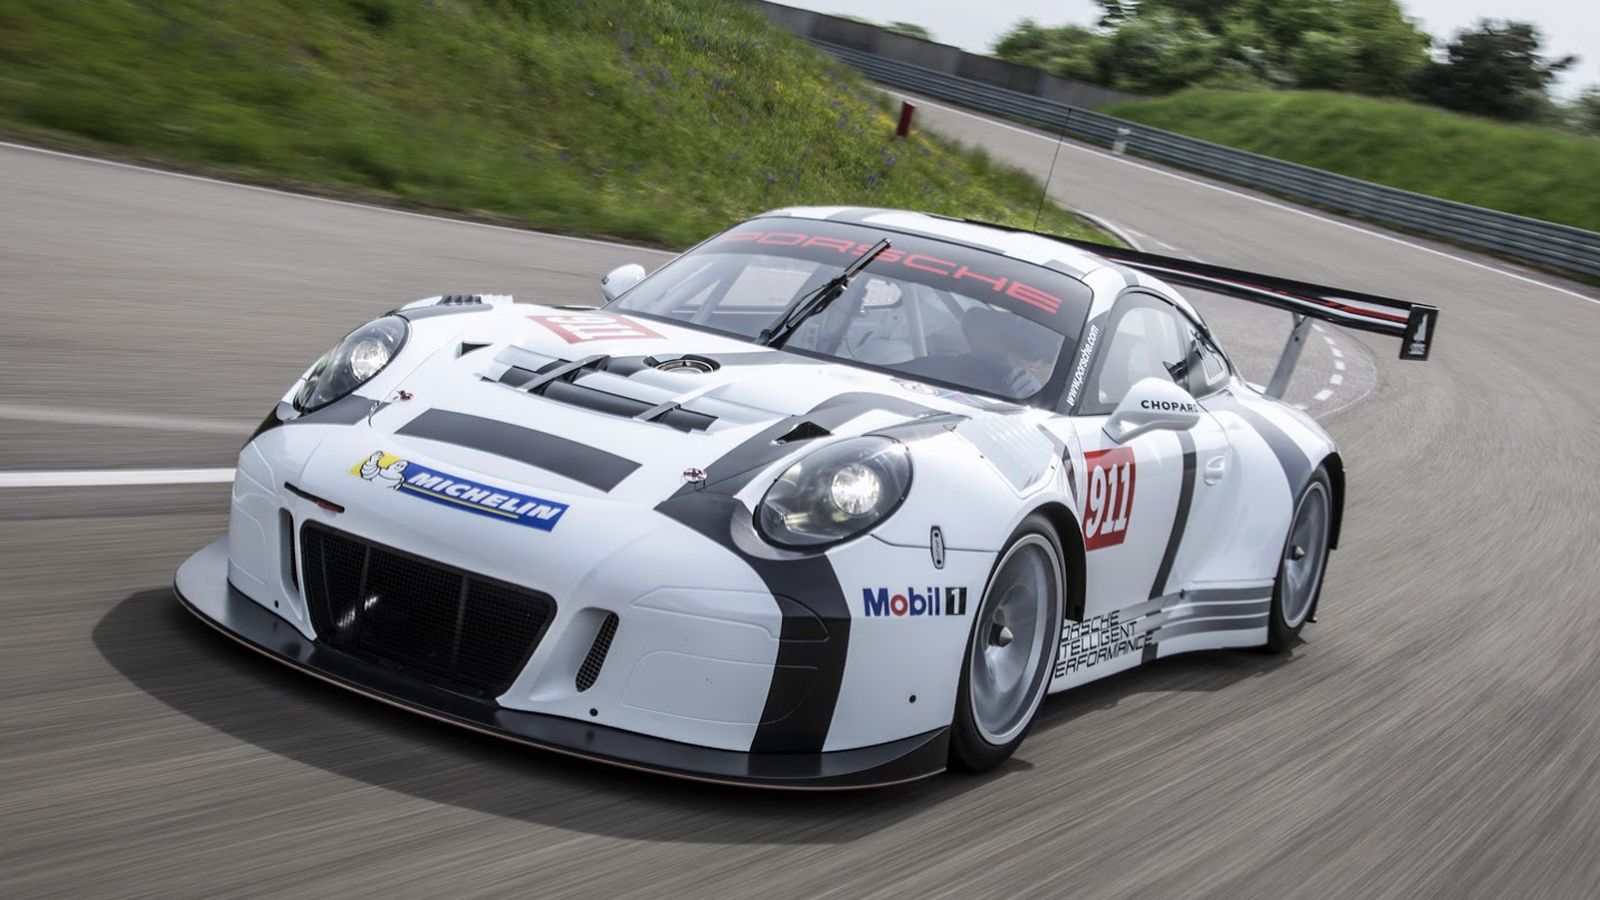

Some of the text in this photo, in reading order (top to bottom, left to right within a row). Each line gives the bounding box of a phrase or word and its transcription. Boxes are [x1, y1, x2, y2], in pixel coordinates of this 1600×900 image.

[720, 232, 1063, 314] PORSCHE
[1066, 324, 1099, 407] www.porsche.com
[408, 472, 562, 521] MICHELIN
[1085, 462, 1131, 539] 911
[862, 587, 940, 616] Mobil
[1061, 609, 1120, 641] ORSCHE
[1054, 630, 1154, 679] ERFORMANCE
[1060, 621, 1138, 658] TELLIGENT
